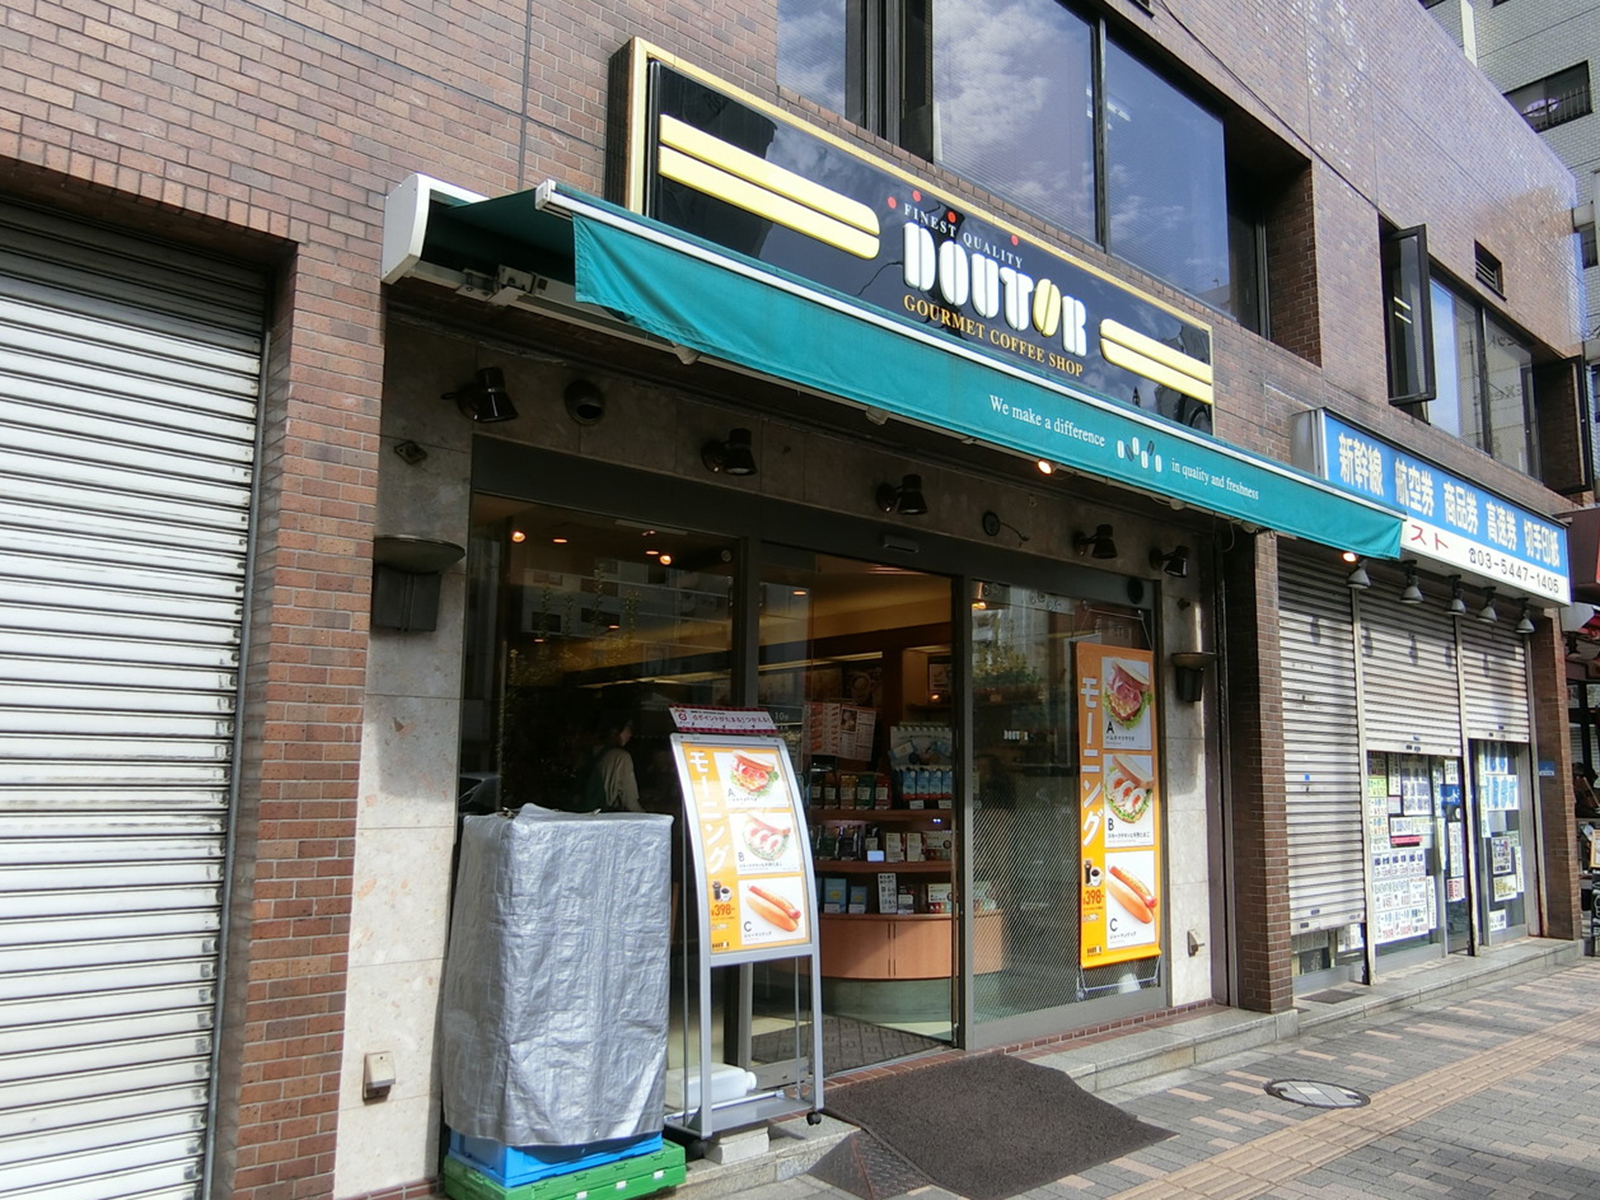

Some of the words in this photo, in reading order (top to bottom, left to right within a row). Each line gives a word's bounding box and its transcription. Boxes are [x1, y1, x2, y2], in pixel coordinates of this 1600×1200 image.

[904, 203, 956, 238] FINEST
[963, 231, 1023, 269] QUALITY
[903, 221, 1087, 357] DOUTOR
[903, 294, 985, 339] GOURMET
[989, 329, 1045, 364] COFFEE
[1048, 353, 1083, 378] SHOP
[989, 394, 1009, 416] We
[1012, 401, 1042, 427] make
[1044, 418, 1052, 430] a
[1054, 417, 1106, 448] difference
[1171, 458, 1181, 474] in
[1182, 464, 1209, 486] quality
[1211, 473, 1225, 488] and
[1226, 477, 1260, 500] freshness
[1338, 432, 1384, 497] 新幹線
[1395, 457, 1435, 518] 航空券
[1443, 481, 1479, 536] 商品券
[1486, 501, 1518, 552] 高速券
[1523, 518, 1561, 568] 切手印紙
[1477, 549, 1560, 594] 03-5447-1405
[1106, 721, 1115, 734] A
[1080, 676, 1105, 847] モーニング
[690, 751, 730, 875] モーニング
[1107, 817, 1115, 831] B
[743, 920, 752, 932] C
[1109, 918, 1119, 932] C
